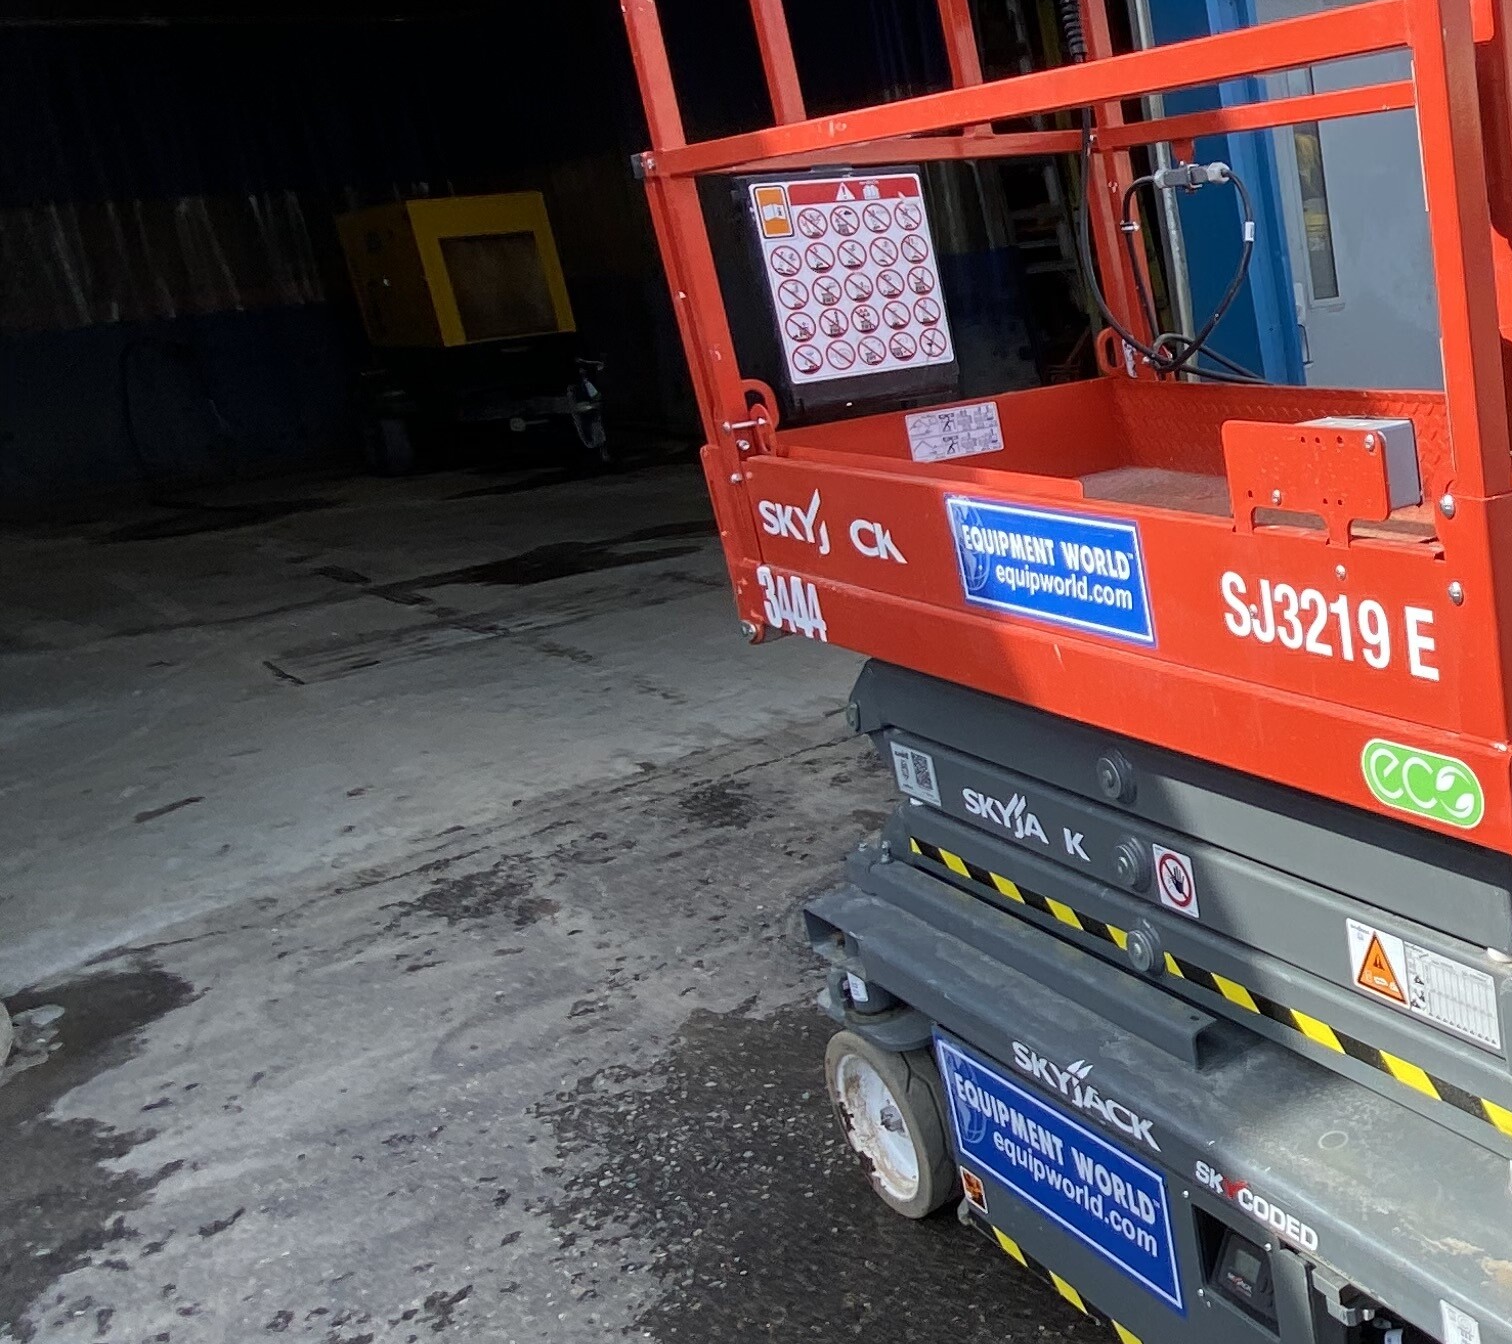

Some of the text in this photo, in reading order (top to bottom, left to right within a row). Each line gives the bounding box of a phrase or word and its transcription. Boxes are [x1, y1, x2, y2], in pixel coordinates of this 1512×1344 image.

[961, 524, 1131, 581] EQUIPMENT WORLD
[995, 563, 1133, 611] equipworld.com
[1220, 570, 1440, 682] SJ3219 E
[953, 1071, 1157, 1225] EQUIPMENT WORLD
[1012, 1040, 1162, 1152] SKYJACK
[992, 1130, 1158, 1257] equipworld.com
